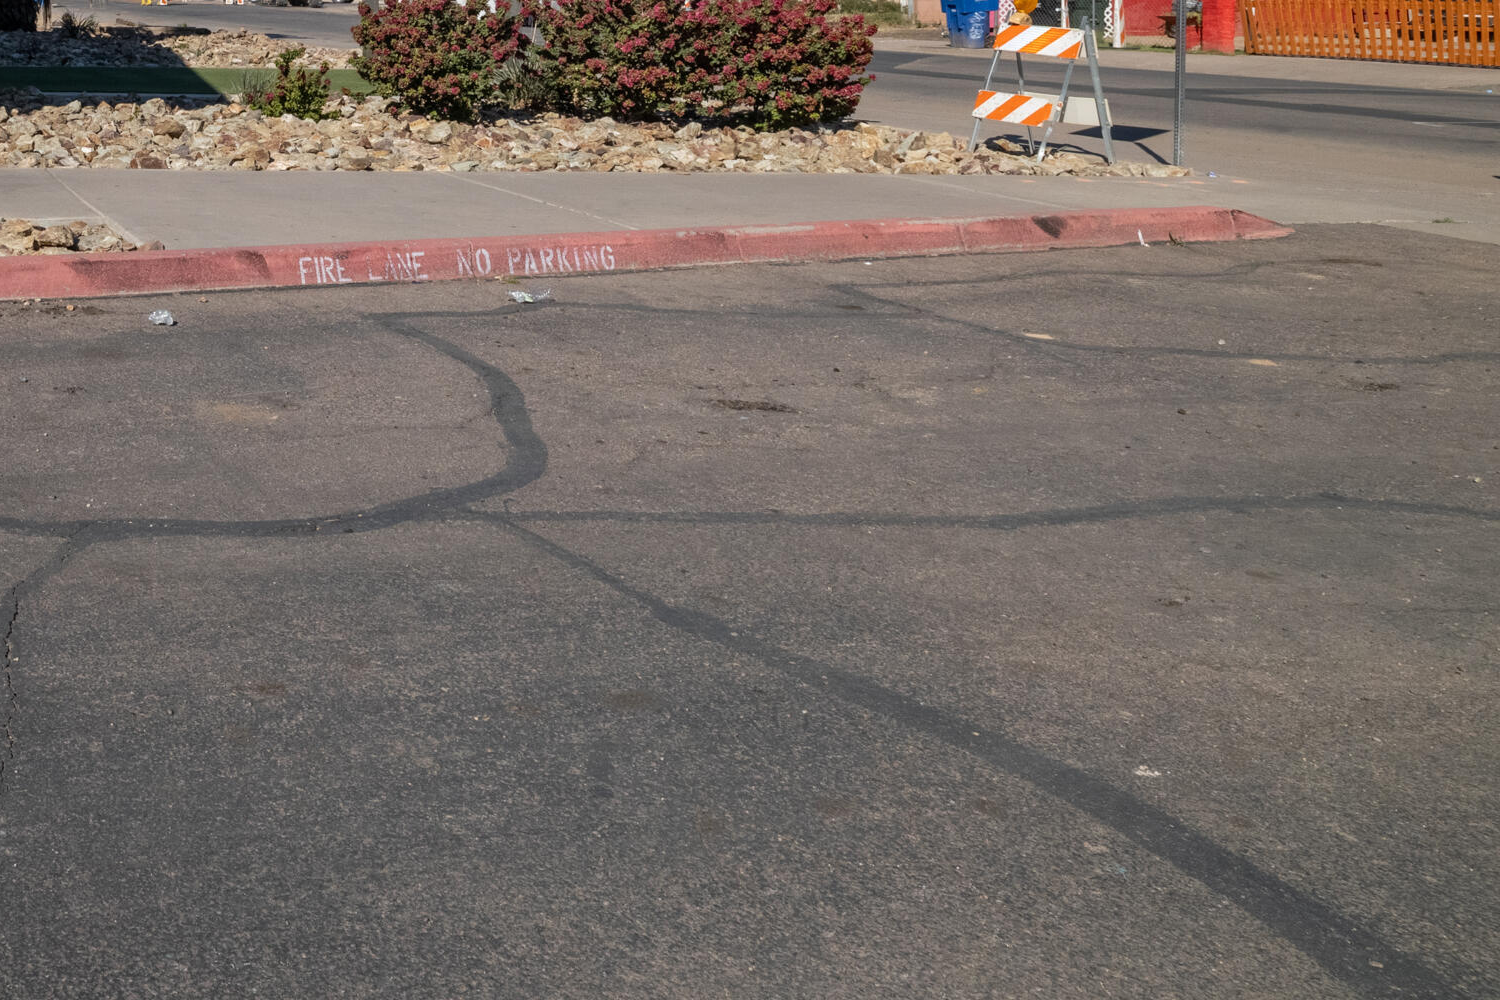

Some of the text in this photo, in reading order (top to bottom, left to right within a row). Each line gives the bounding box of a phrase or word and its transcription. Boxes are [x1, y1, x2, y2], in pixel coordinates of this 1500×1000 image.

[298, 245, 616, 284] FIRE LANE NO PARKING
